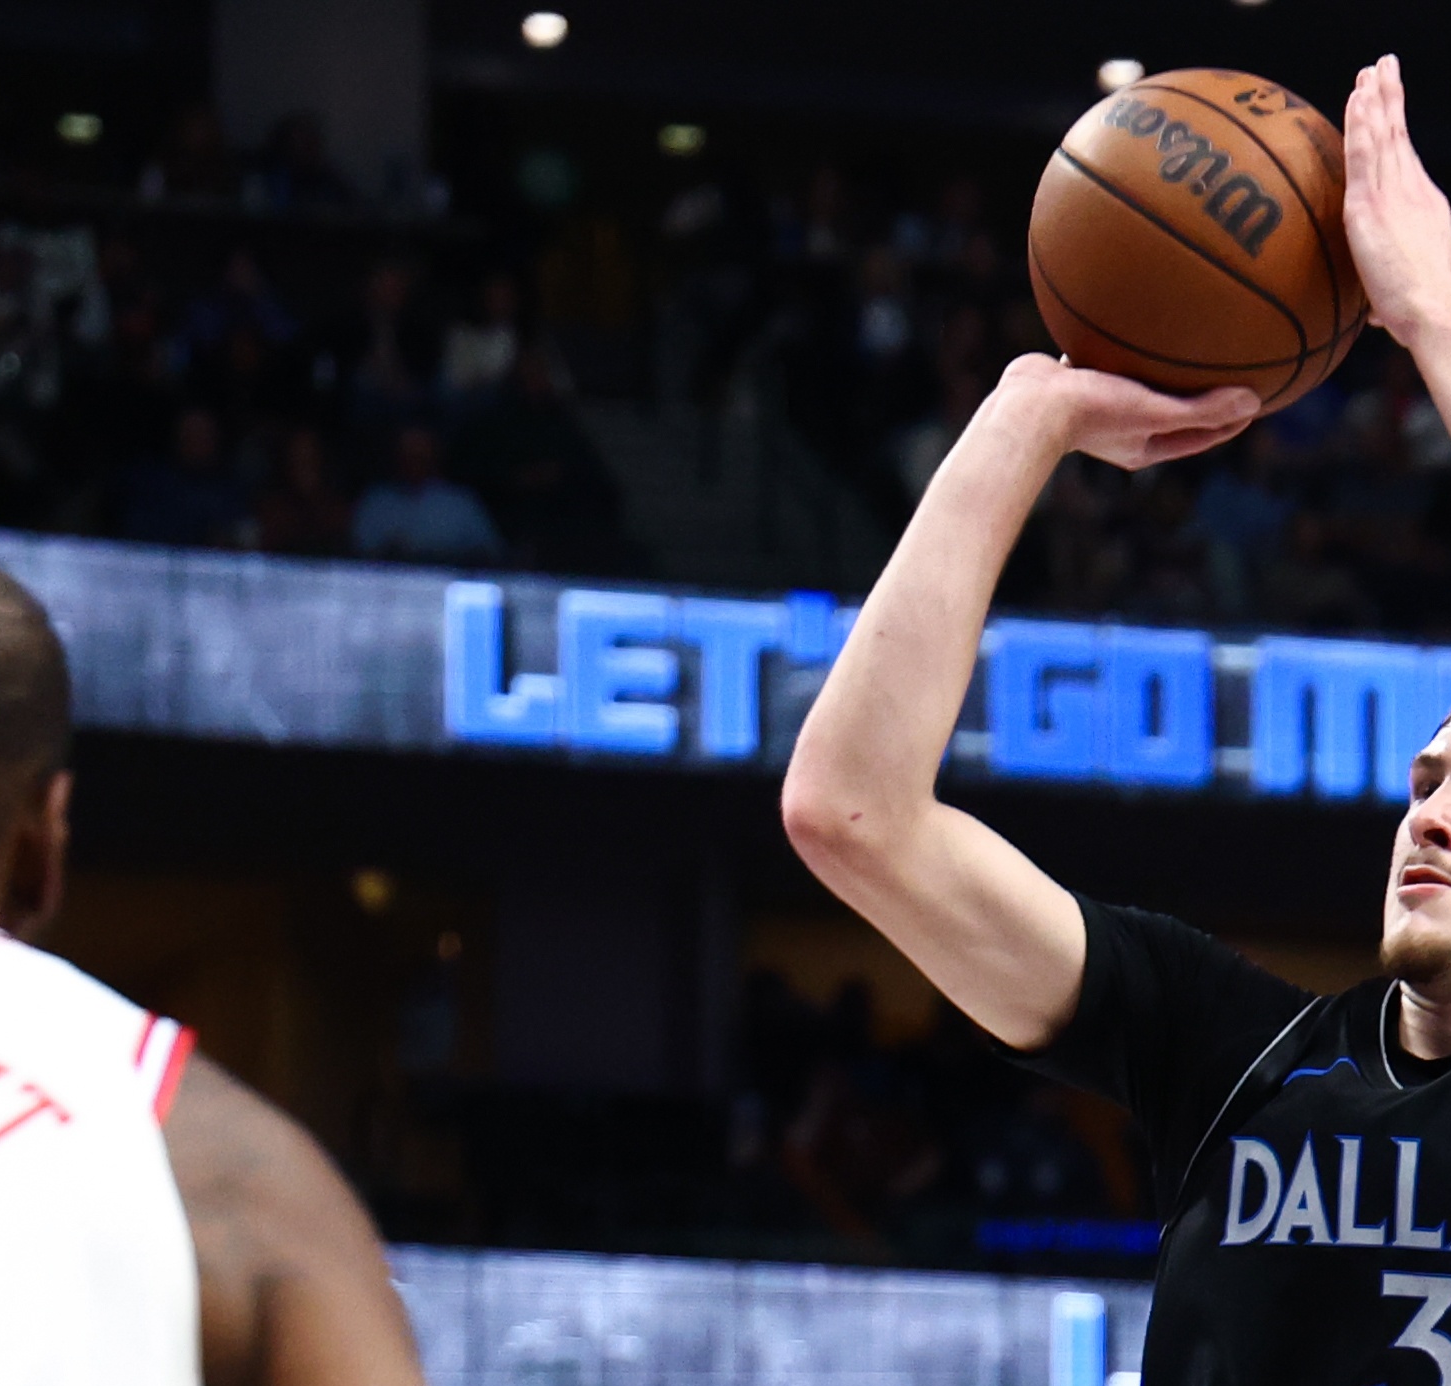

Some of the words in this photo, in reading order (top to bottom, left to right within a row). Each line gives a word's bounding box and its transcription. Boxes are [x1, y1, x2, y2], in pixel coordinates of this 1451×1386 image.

[1104, 98, 1285, 259] Wilson
[443, 581, 861, 758] LET'
[986, 618, 1215, 790] GO
